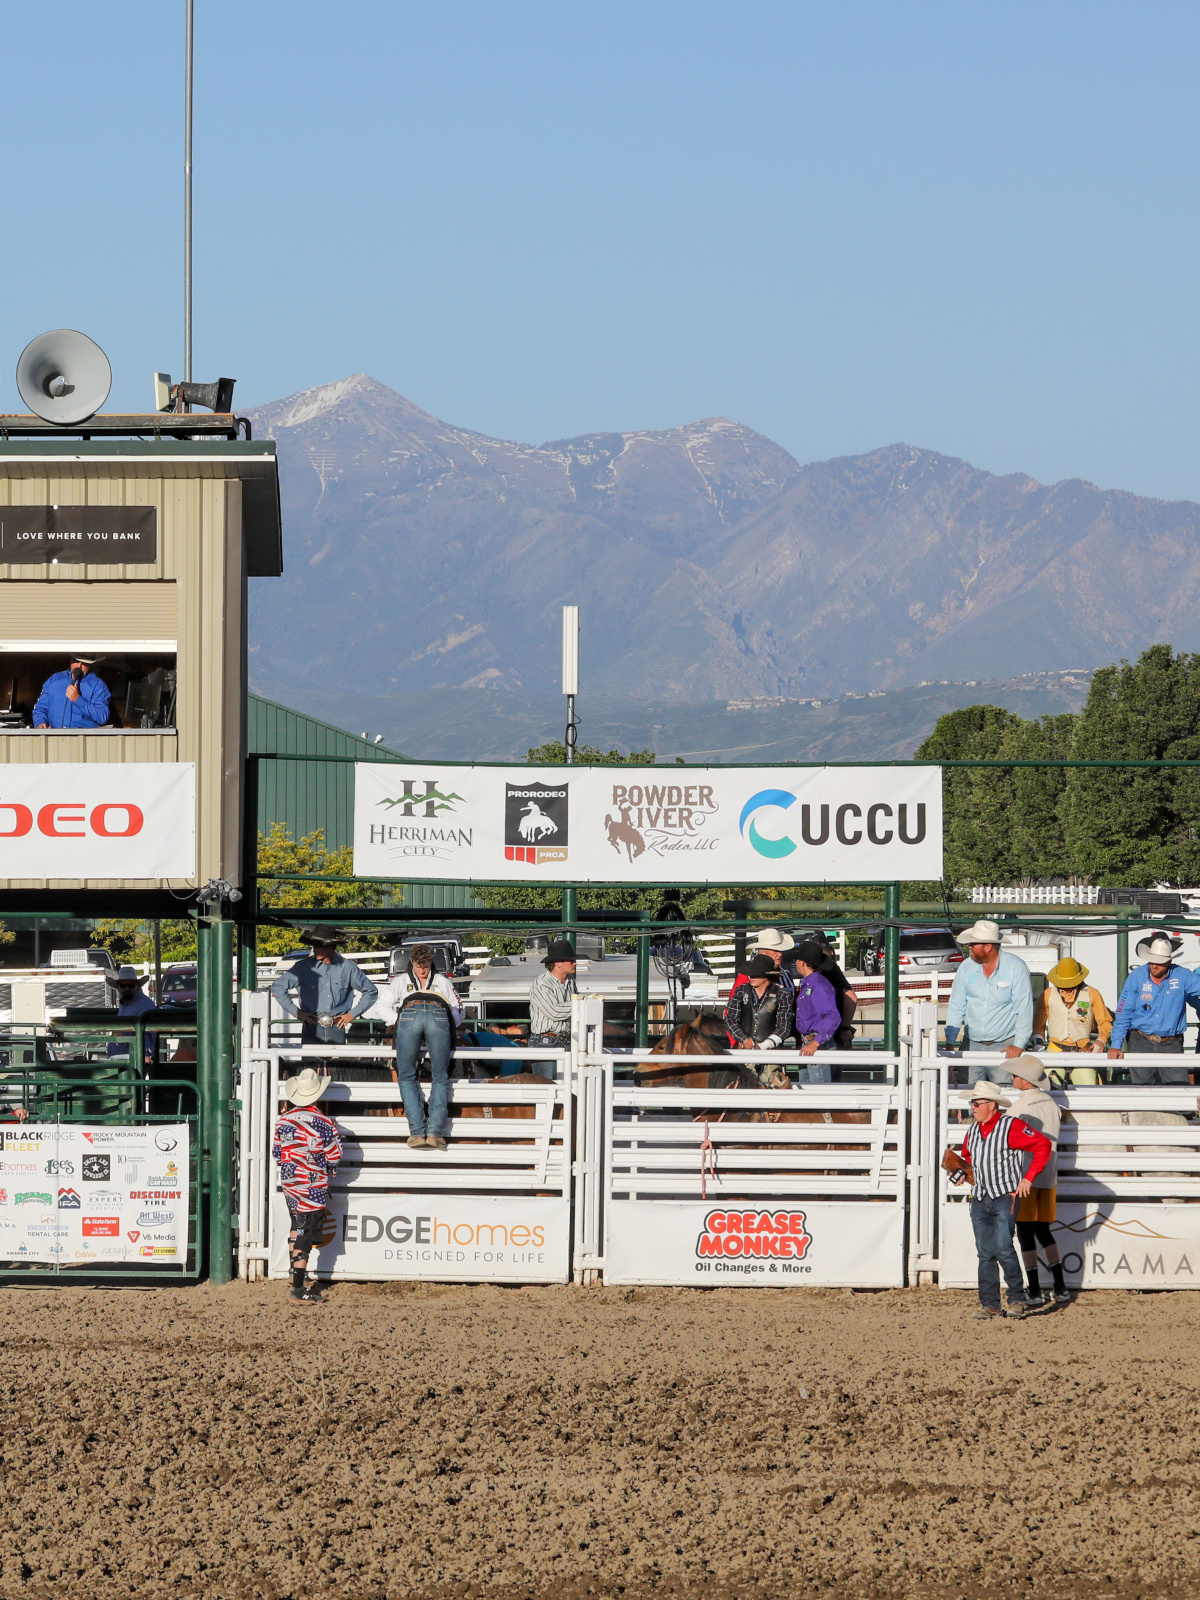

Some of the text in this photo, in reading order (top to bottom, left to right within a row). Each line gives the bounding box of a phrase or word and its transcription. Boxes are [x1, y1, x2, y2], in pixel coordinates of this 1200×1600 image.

[16, 532, 43, 540] LOVE
[47, 532, 82, 540] WHERE
[86, 532, 108, 540] YOU
[112, 532, 141, 540] BANK
[508, 790, 566, 798] PRORODEO
[612, 784, 716, 808] POWDER
[802, 803, 926, 846] UCCU
[369, 824, 473, 847] HERRIMAN
[402, 847, 438, 856] CITY
[6, 1142, 41, 1152] FLEET
[130, 1191, 182, 1199] DISCOUNT
[342, 1214, 545, 1247] EDGEhomes
[707, 1212, 803, 1234] GREASE
[699, 1234, 810, 1257] MONKEY
[384, 1250, 544, 1264] DESIGNED FOR LIFE
[1037, 1252, 1194, 1276] ORAMA
[695, 1262, 812, 1274] Oil Changes & More
